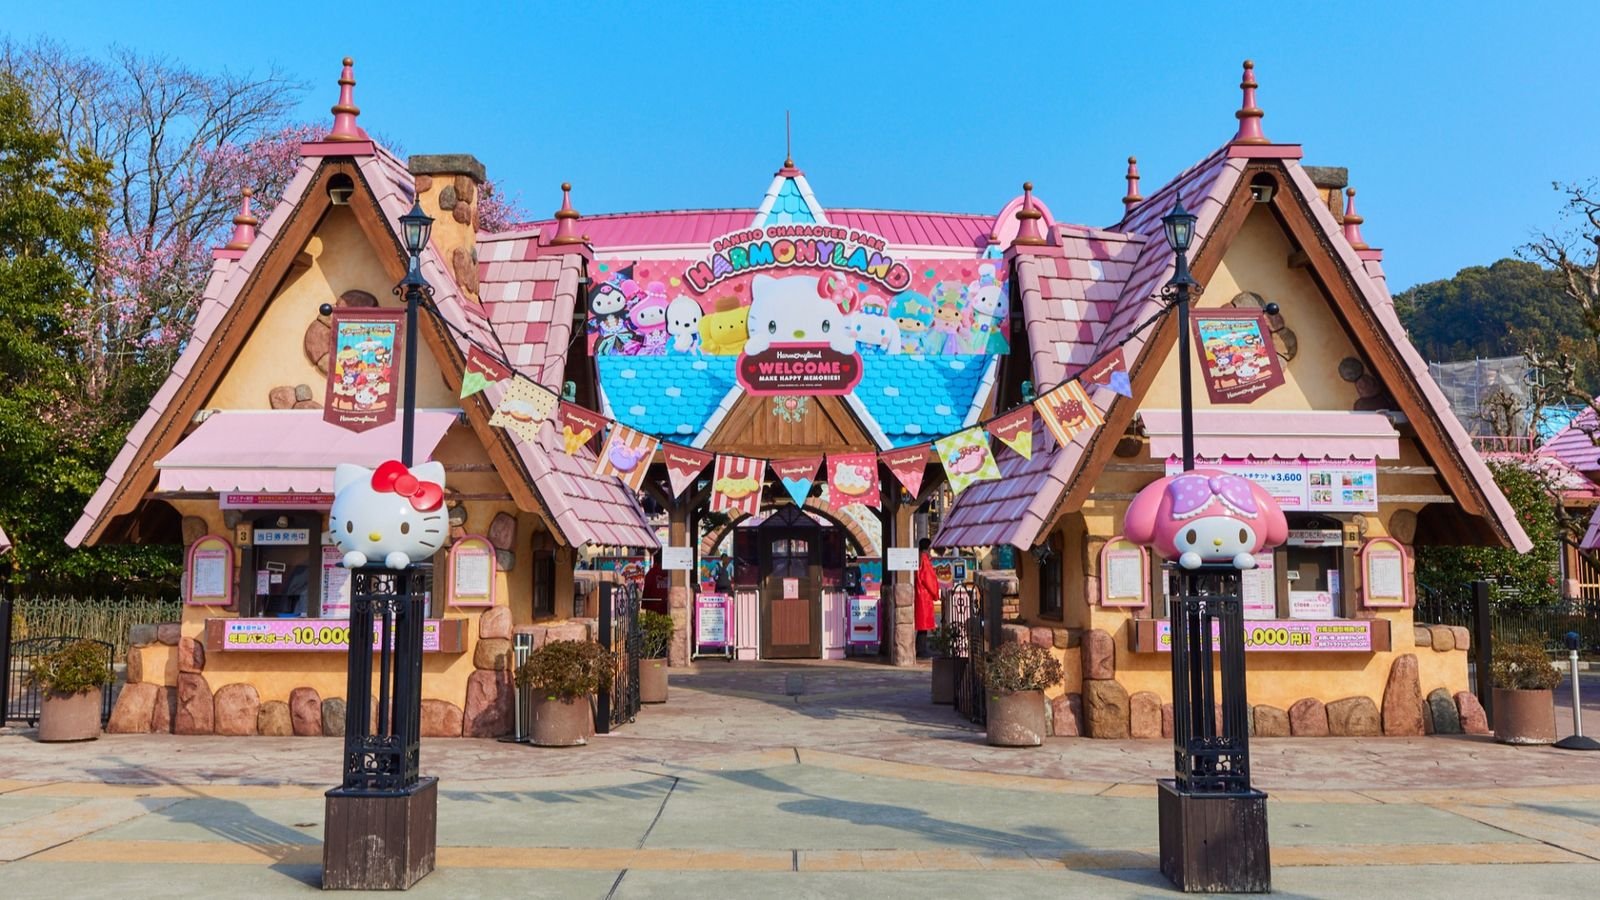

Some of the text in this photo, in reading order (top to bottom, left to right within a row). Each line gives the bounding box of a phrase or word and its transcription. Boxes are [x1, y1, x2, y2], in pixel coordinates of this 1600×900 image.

[713, 225, 886, 252] SANRIO CHARACTER PARK
[688, 238, 911, 291] HARMONYLAND
[776, 350, 822, 361] Harmonyland
[758, 361, 841, 375] WELCOME
[1271, 472, 1303, 482] ¥3,600
[240, 531, 247, 541] 3
[1348, 531, 1356, 541] 6
